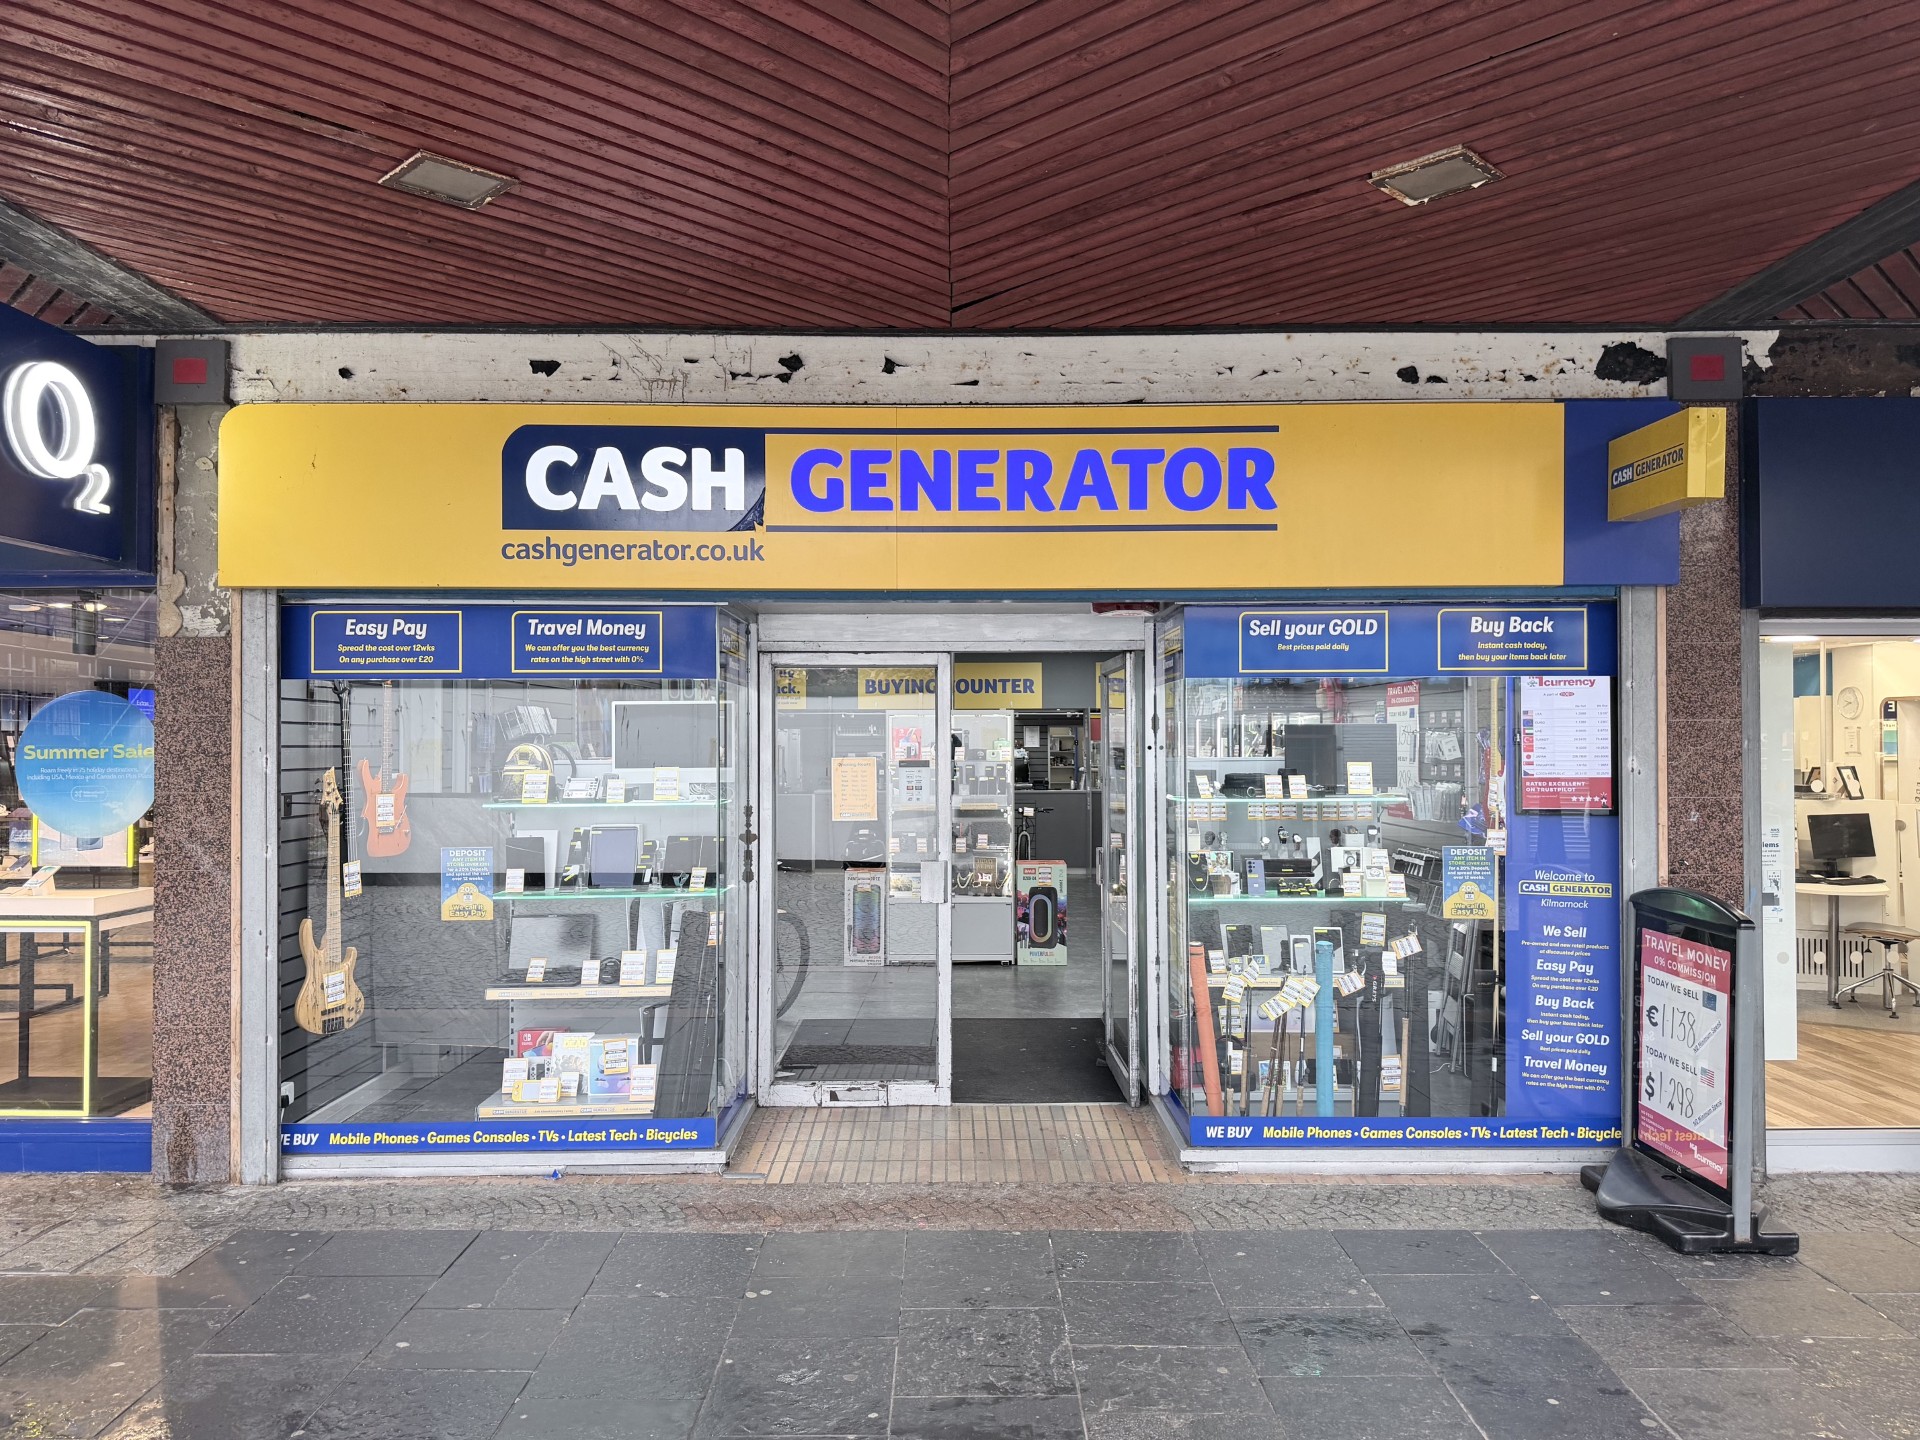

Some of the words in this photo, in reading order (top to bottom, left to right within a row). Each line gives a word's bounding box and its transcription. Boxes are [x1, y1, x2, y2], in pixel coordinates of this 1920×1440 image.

[1612, 466, 1632, 485] CASH
[1635, 447, 1684, 477] GENERATOR
[525, 445, 745, 512] CASH
[790, 447, 1278, 512] GENERATOR
[501, 536, 765, 566] cashgenerator.co.uk
[345, 619, 388, 640] Easy
[392, 619, 427, 640] Pay
[528, 619, 582, 636] Travel
[586, 619, 646, 640] Money
[1249, 619, 1281, 636] Sell
[1284, 623, 1325, 640] your
[1328, 619, 1378, 636] GOLD
[1470, 616, 1505, 638] Buy
[1509, 616, 1554, 633] Back
[338, 644, 364, 652] Spread
[571, 645, 586, 653] you
[617, 645, 649, 653] currency
[1315, 643, 1331, 651] paid
[1332, 643, 1349, 651] daily
[1523, 642, 1547, 650] today,
[366, 656, 400, 664] purchase
[574, 656, 590, 664] high
[1476, 654, 1490, 662] buy
[864, 678, 936, 694] BUYING
[953, 678, 1035, 694] OUNTER
[23, 744, 109, 760] Summer
[113, 743, 154, 759] Sale
[1450, 848, 1487, 856] DEPOSIT
[1534, 870, 1581, 881] Welcome
[1584, 872, 1595, 882] to
[1522, 884, 1548, 892] CASH
[1552, 885, 1611, 894] GENERATOR
[1541, 899, 1589, 909] Kilmarnock
[449, 910, 470, 918] Easy
[1451, 909, 1471, 917] Easy
[1472, 909, 1488, 917] Pay
[1543, 925, 1561, 937] We
[1564, 926, 1587, 938] Sell
[1645, 934, 1684, 958] TRAVEL
[1687, 947, 1728, 972] MONEY
[1536, 959, 1566, 974] Easy
[1569, 961, 1594, 976] Pay
[1654, 955, 1665, 967] 0%
[1667, 960, 1716, 984] COMMISSION
[1647, 974, 1669, 988] TODAY
[1670, 982, 1681, 994] WE
[1682, 987, 1699, 1001] SELL
[1535, 995, 1559, 1010] Buy
[1562, 996, 1595, 1009] Back
[1521, 1029, 1543, 1041] Sell
[1545, 1034, 1573, 1044] your
[1576, 1033, 1609, 1046] GOLD
[1524, 1056, 1561, 1070] Travel
[1564, 1059, 1607, 1076] Money
[1645, 1045, 1667, 1062] TODAY
[1668, 1055, 1679, 1067] WE
[1681, 1061, 1697, 1076] SELL
[293, 1133, 320, 1146] BUY
[329, 1132, 370, 1145] Mobile
[373, 1132, 419, 1144] Phones
[427, 1131, 470, 1144] Games
[473, 1131, 530, 1143] Consoles
[538, 1130, 559, 1142] TVs
[567, 1129, 606, 1142] Latest
[608, 1129, 637, 1141] Tech
[646, 1128, 698, 1143] Bicycles
[1206, 1126, 1224, 1138] WE
[1227, 1126, 1253, 1138] BUY
[1263, 1126, 1304, 1139] Mobile
[1306, 1126, 1352, 1139] Phones
[1360, 1126, 1403, 1139] Games
[1405, 1126, 1462, 1139] Consoles
[1470, 1127, 1491, 1139] TVs
[1500, 1127, 1537, 1139] Latest
[1540, 1127, 1568, 1139] Tech
[1576, 1127, 1622, 1142] Bicycle
